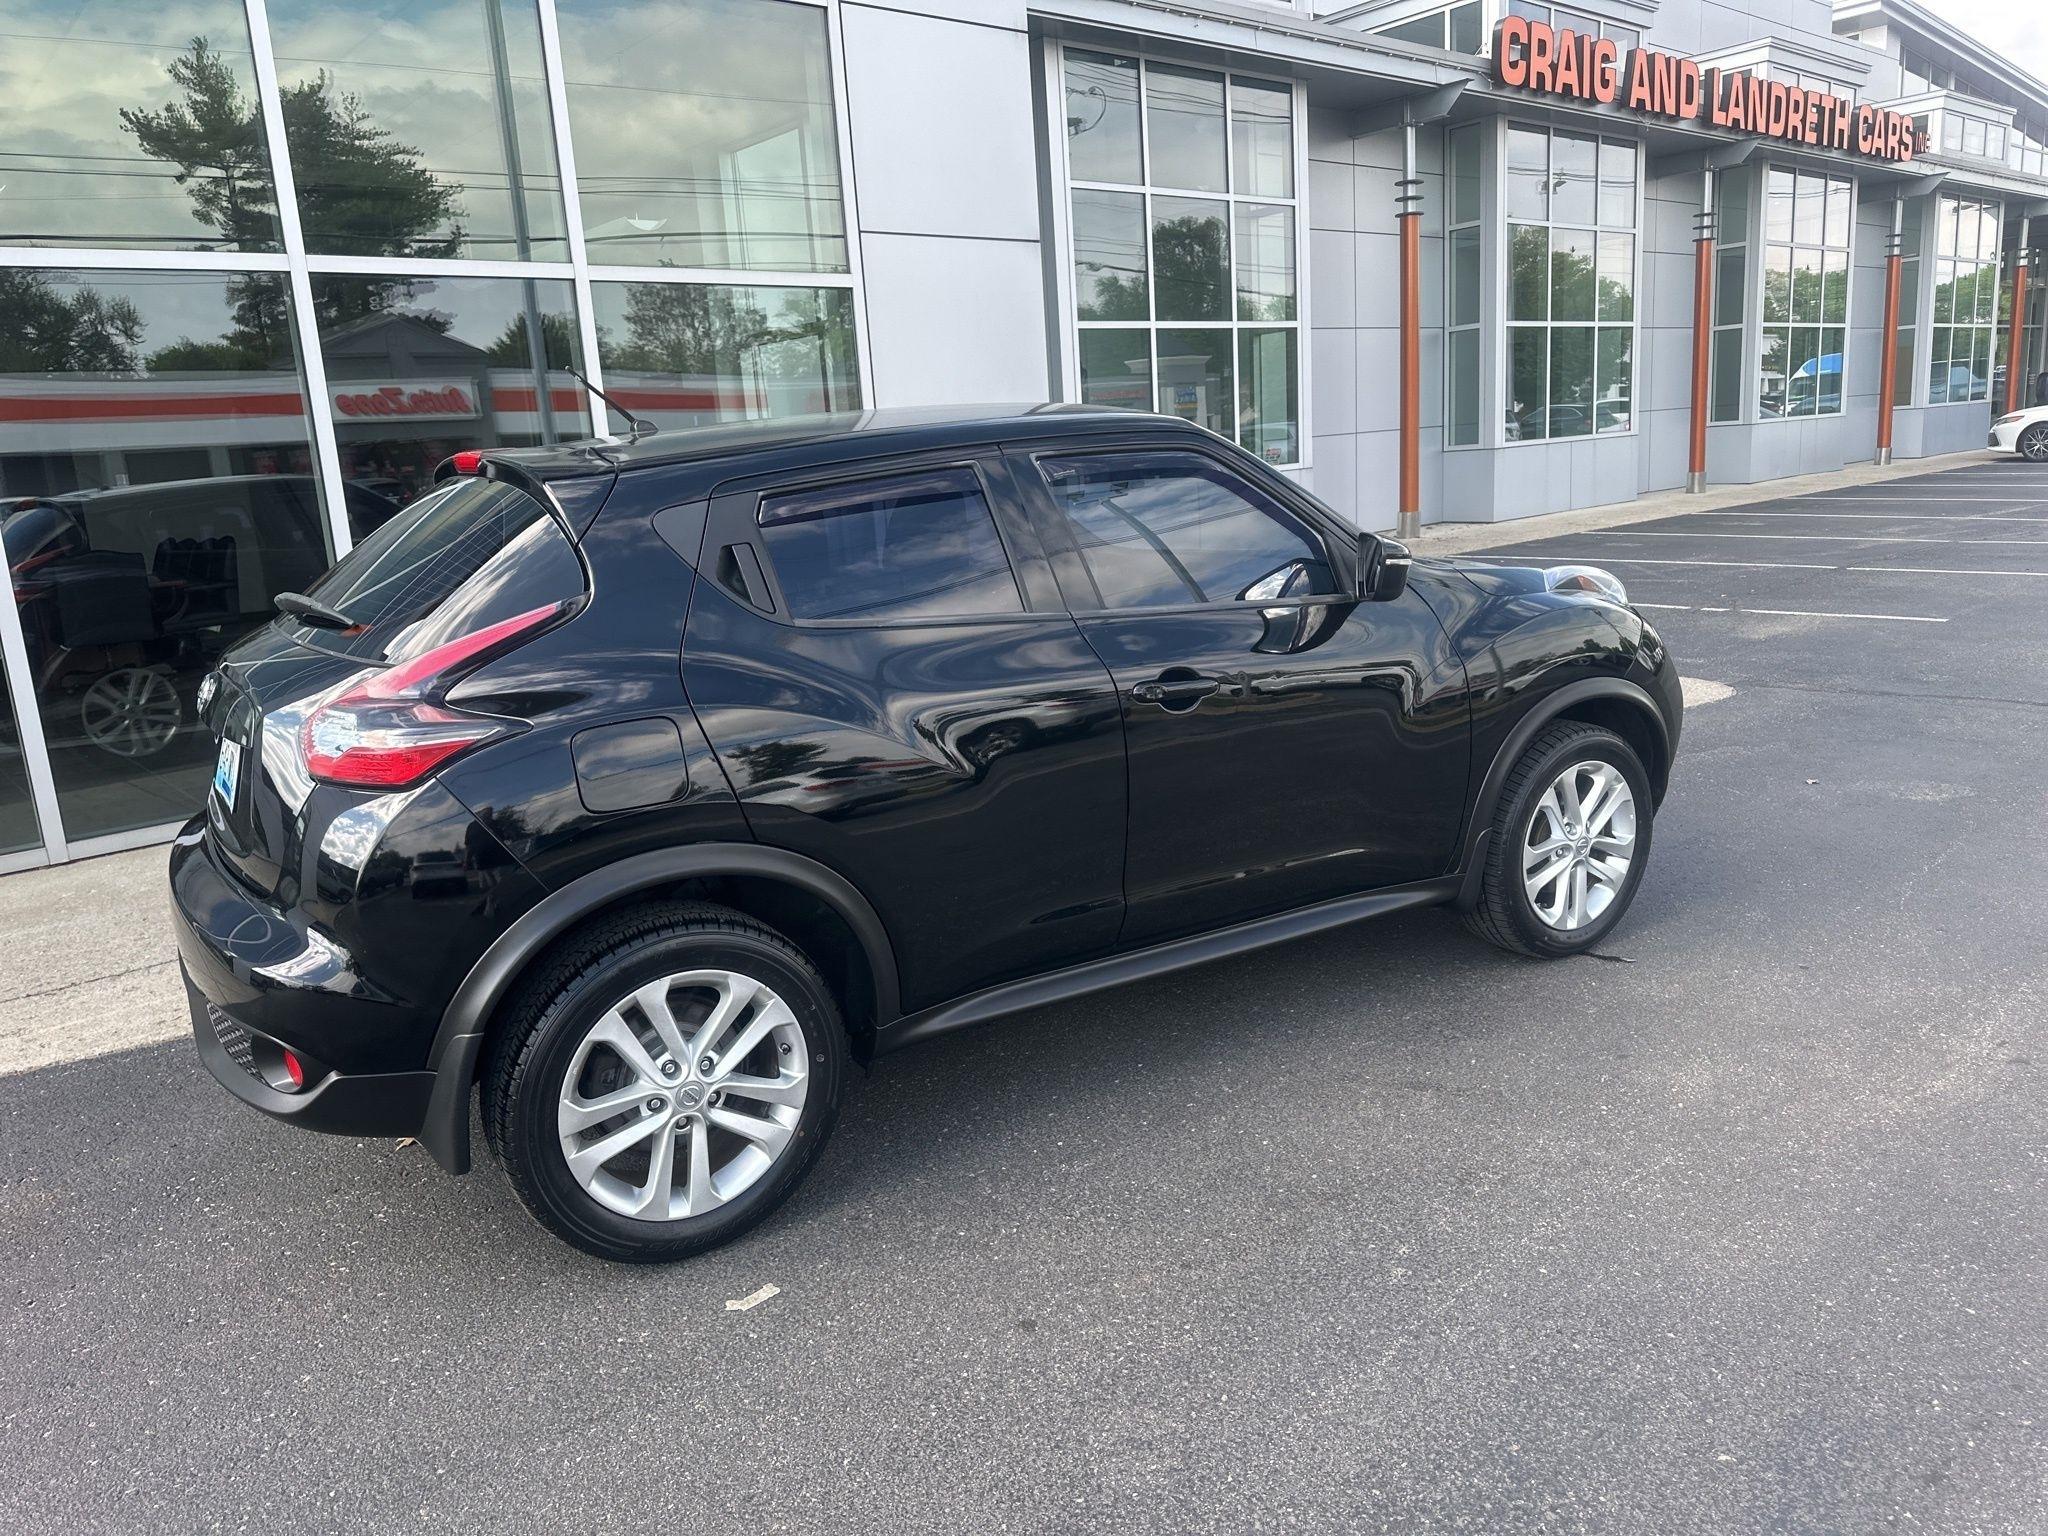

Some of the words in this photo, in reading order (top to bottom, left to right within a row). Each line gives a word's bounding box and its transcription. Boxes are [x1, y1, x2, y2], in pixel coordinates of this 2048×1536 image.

[1498, 15, 1618, 103] CRAIG
[1627, 48, 1700, 120] AND
[1710, 67, 1851, 150] LANDRETH
[1856, 103, 1914, 162] CARS
